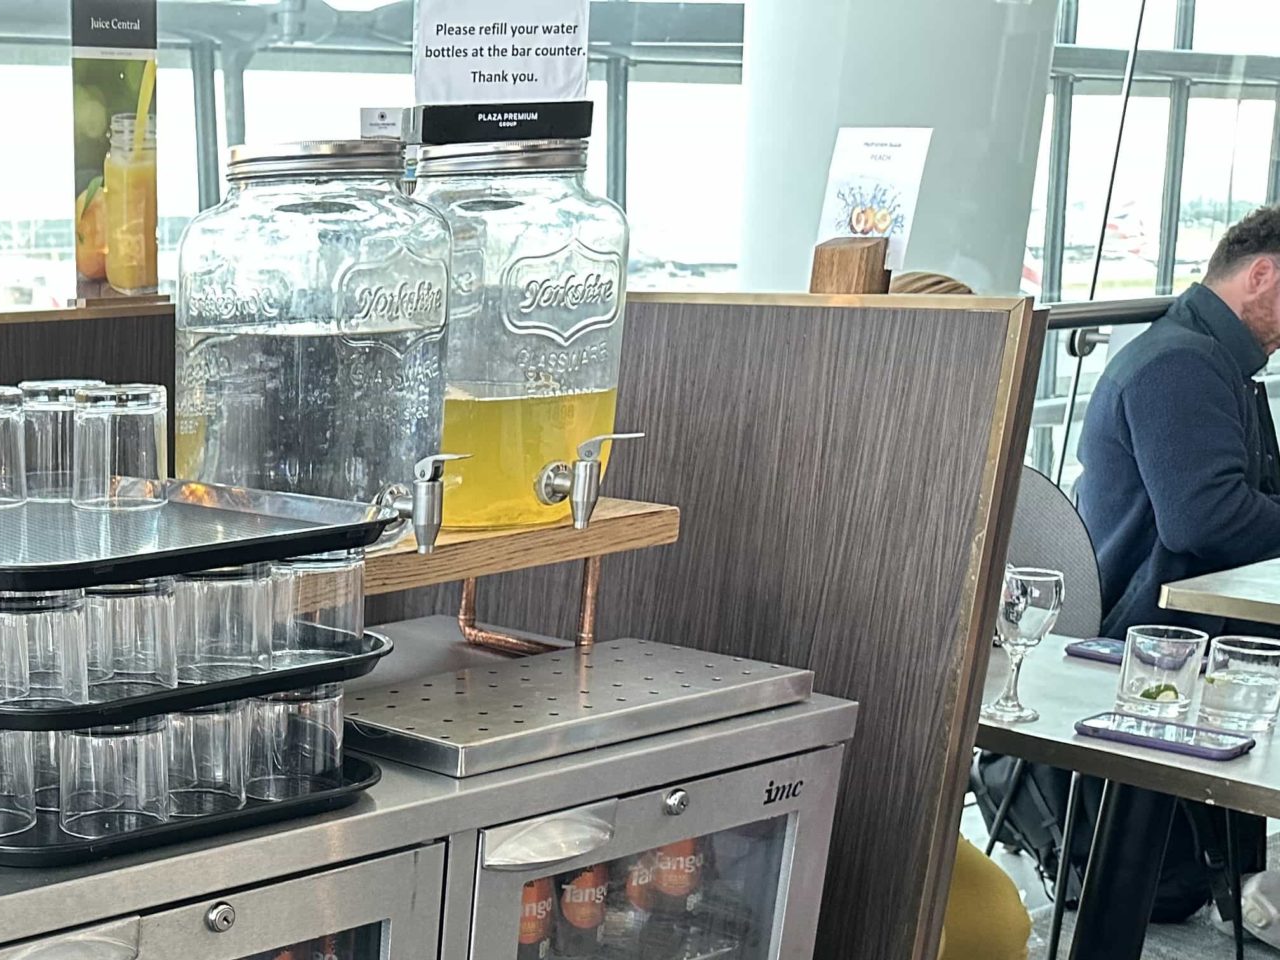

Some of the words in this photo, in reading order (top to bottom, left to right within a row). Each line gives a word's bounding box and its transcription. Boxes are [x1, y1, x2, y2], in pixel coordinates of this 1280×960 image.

[90, 17, 110, 30] Juice
[111, 18, 141, 30] Central
[435, 23, 476, 36] Please
[479, 23, 508, 35] refill
[510, 25, 539, 37] your
[542, 23, 579, 35] water
[425, 45, 468, 58] bottles
[471, 46, 485, 57] at
[488, 45, 508, 57] the
[511, 44, 532, 57] bar
[534, 45, 587, 57] counter.
[471, 70, 508, 83] Thank
[511, 72, 538, 84] you.
[477, 112, 503, 122] PLAZA
[503, 112, 538, 121] PREMIUM
[520, 273, 615, 313] Yorkshire
[350, 281, 442, 326] Yorkshire
[763, 780, 804, 805] imc
